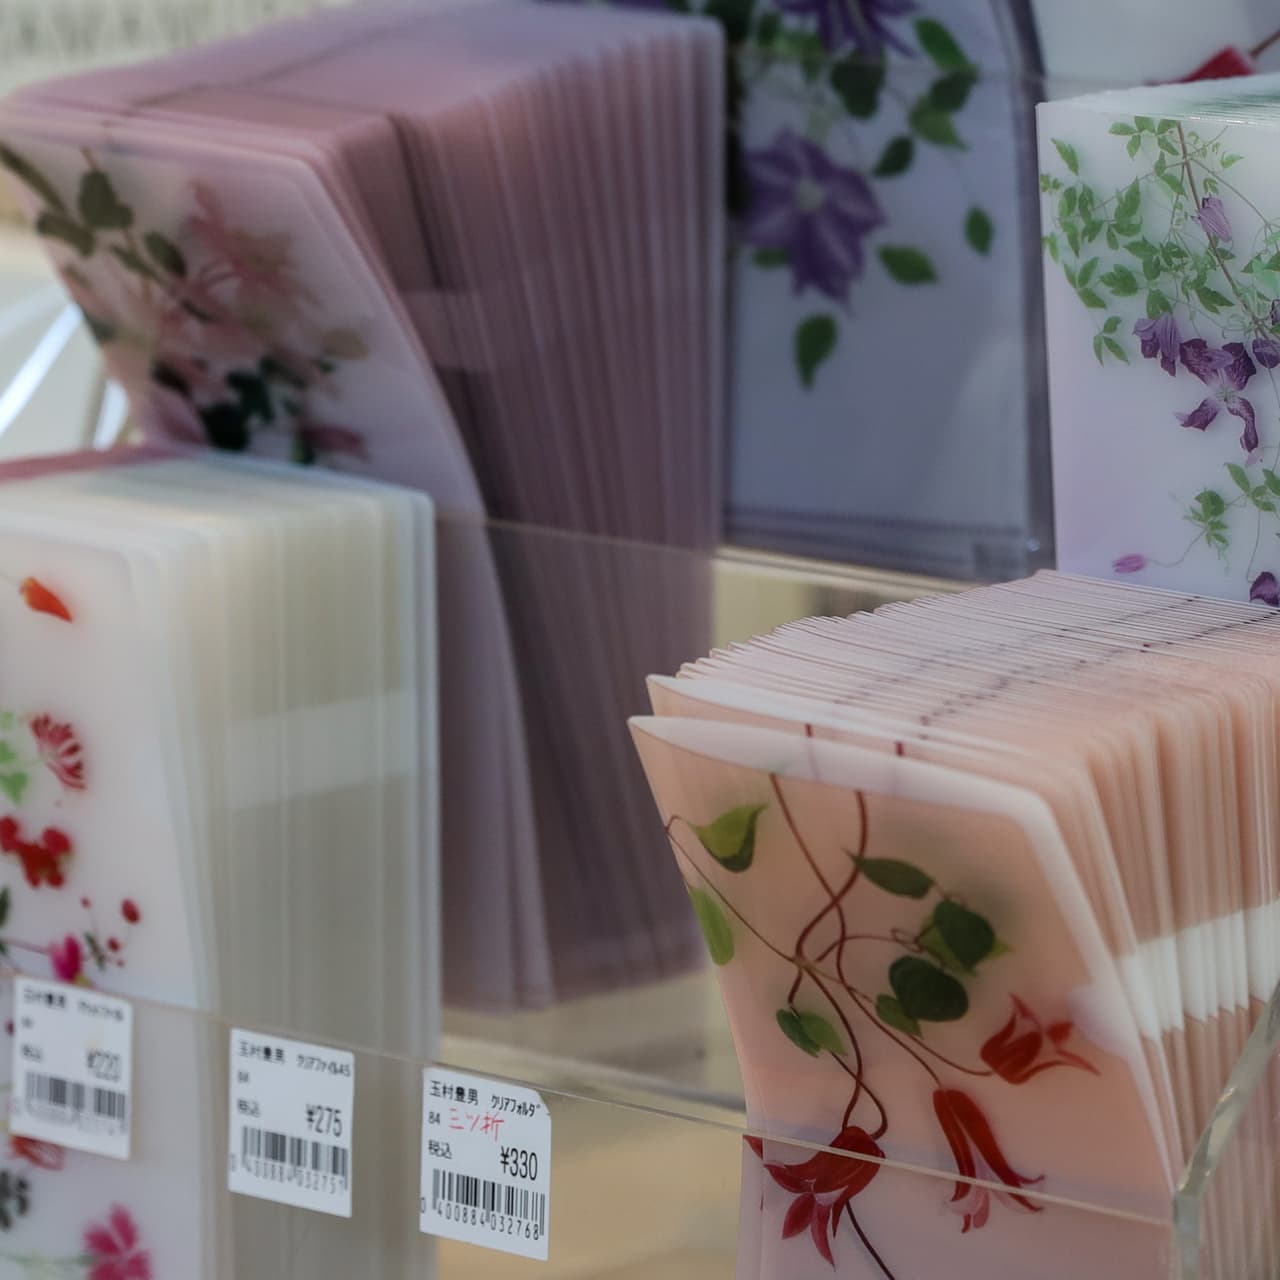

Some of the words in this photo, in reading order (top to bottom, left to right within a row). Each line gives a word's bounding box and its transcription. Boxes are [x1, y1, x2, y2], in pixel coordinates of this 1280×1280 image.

[429, 1080, 479, 1106] 玉村豊男
[306, 1104, 342, 1137] ¥275
[428, 1111, 440, 1125] 84
[428, 1139, 452, 1160] 税込
[500, 1145, 538, 1181] ¥330
